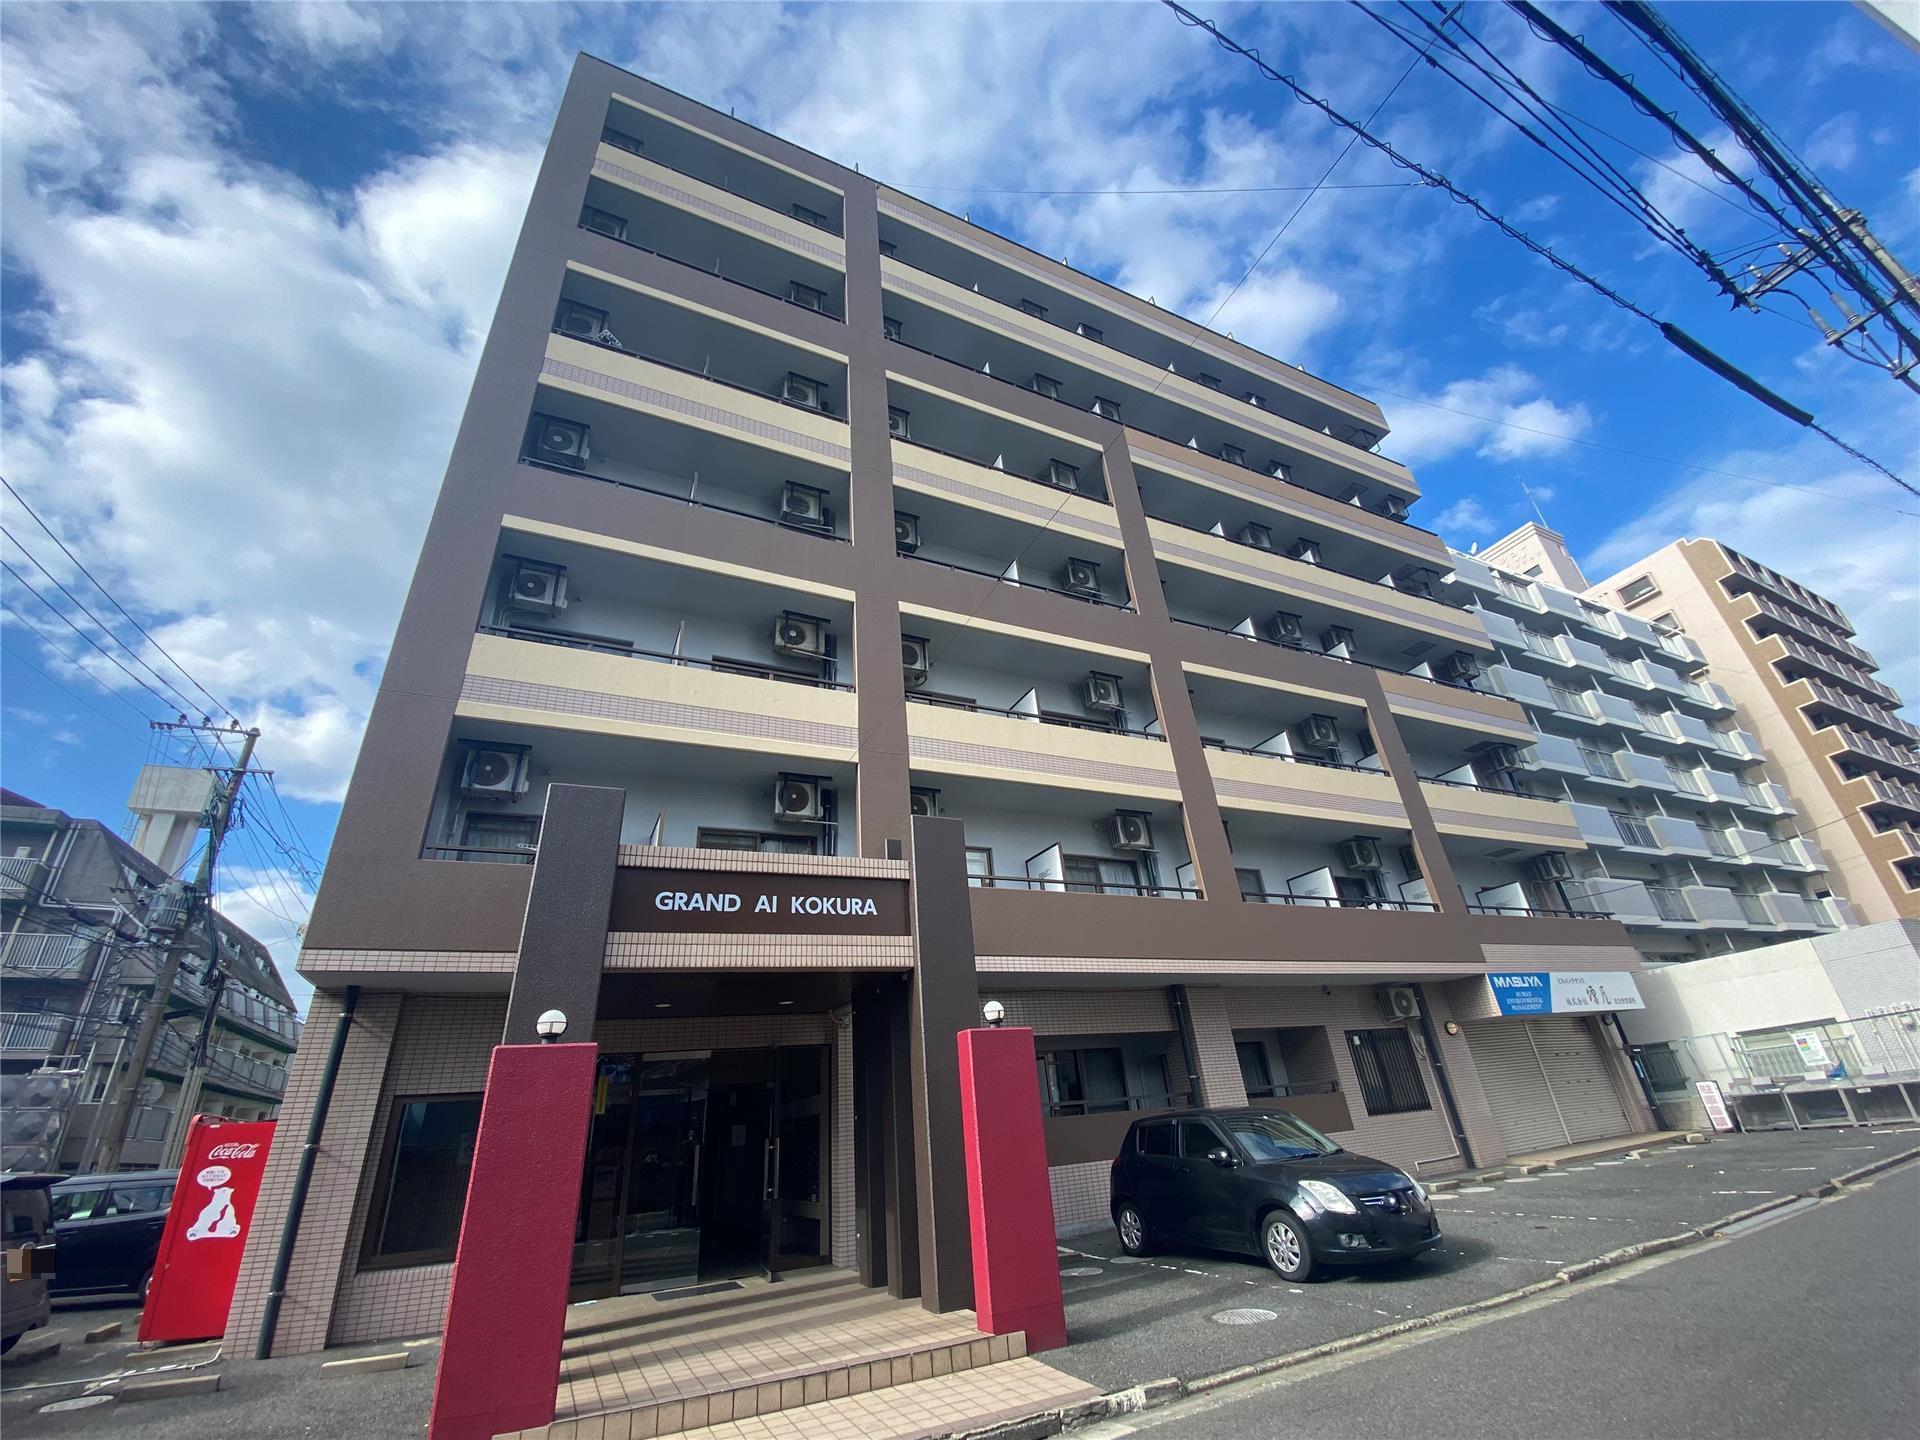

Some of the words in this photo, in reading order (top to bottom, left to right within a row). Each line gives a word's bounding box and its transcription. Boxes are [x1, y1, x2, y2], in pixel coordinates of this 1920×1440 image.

[655, 891, 742, 912] GRAND
[754, 895, 778, 913] AI
[791, 896, 878, 916] KOKURA
[1493, 976, 1543, 988] MASUYA
[208, 1143, 261, 1160] Coca-Cola
